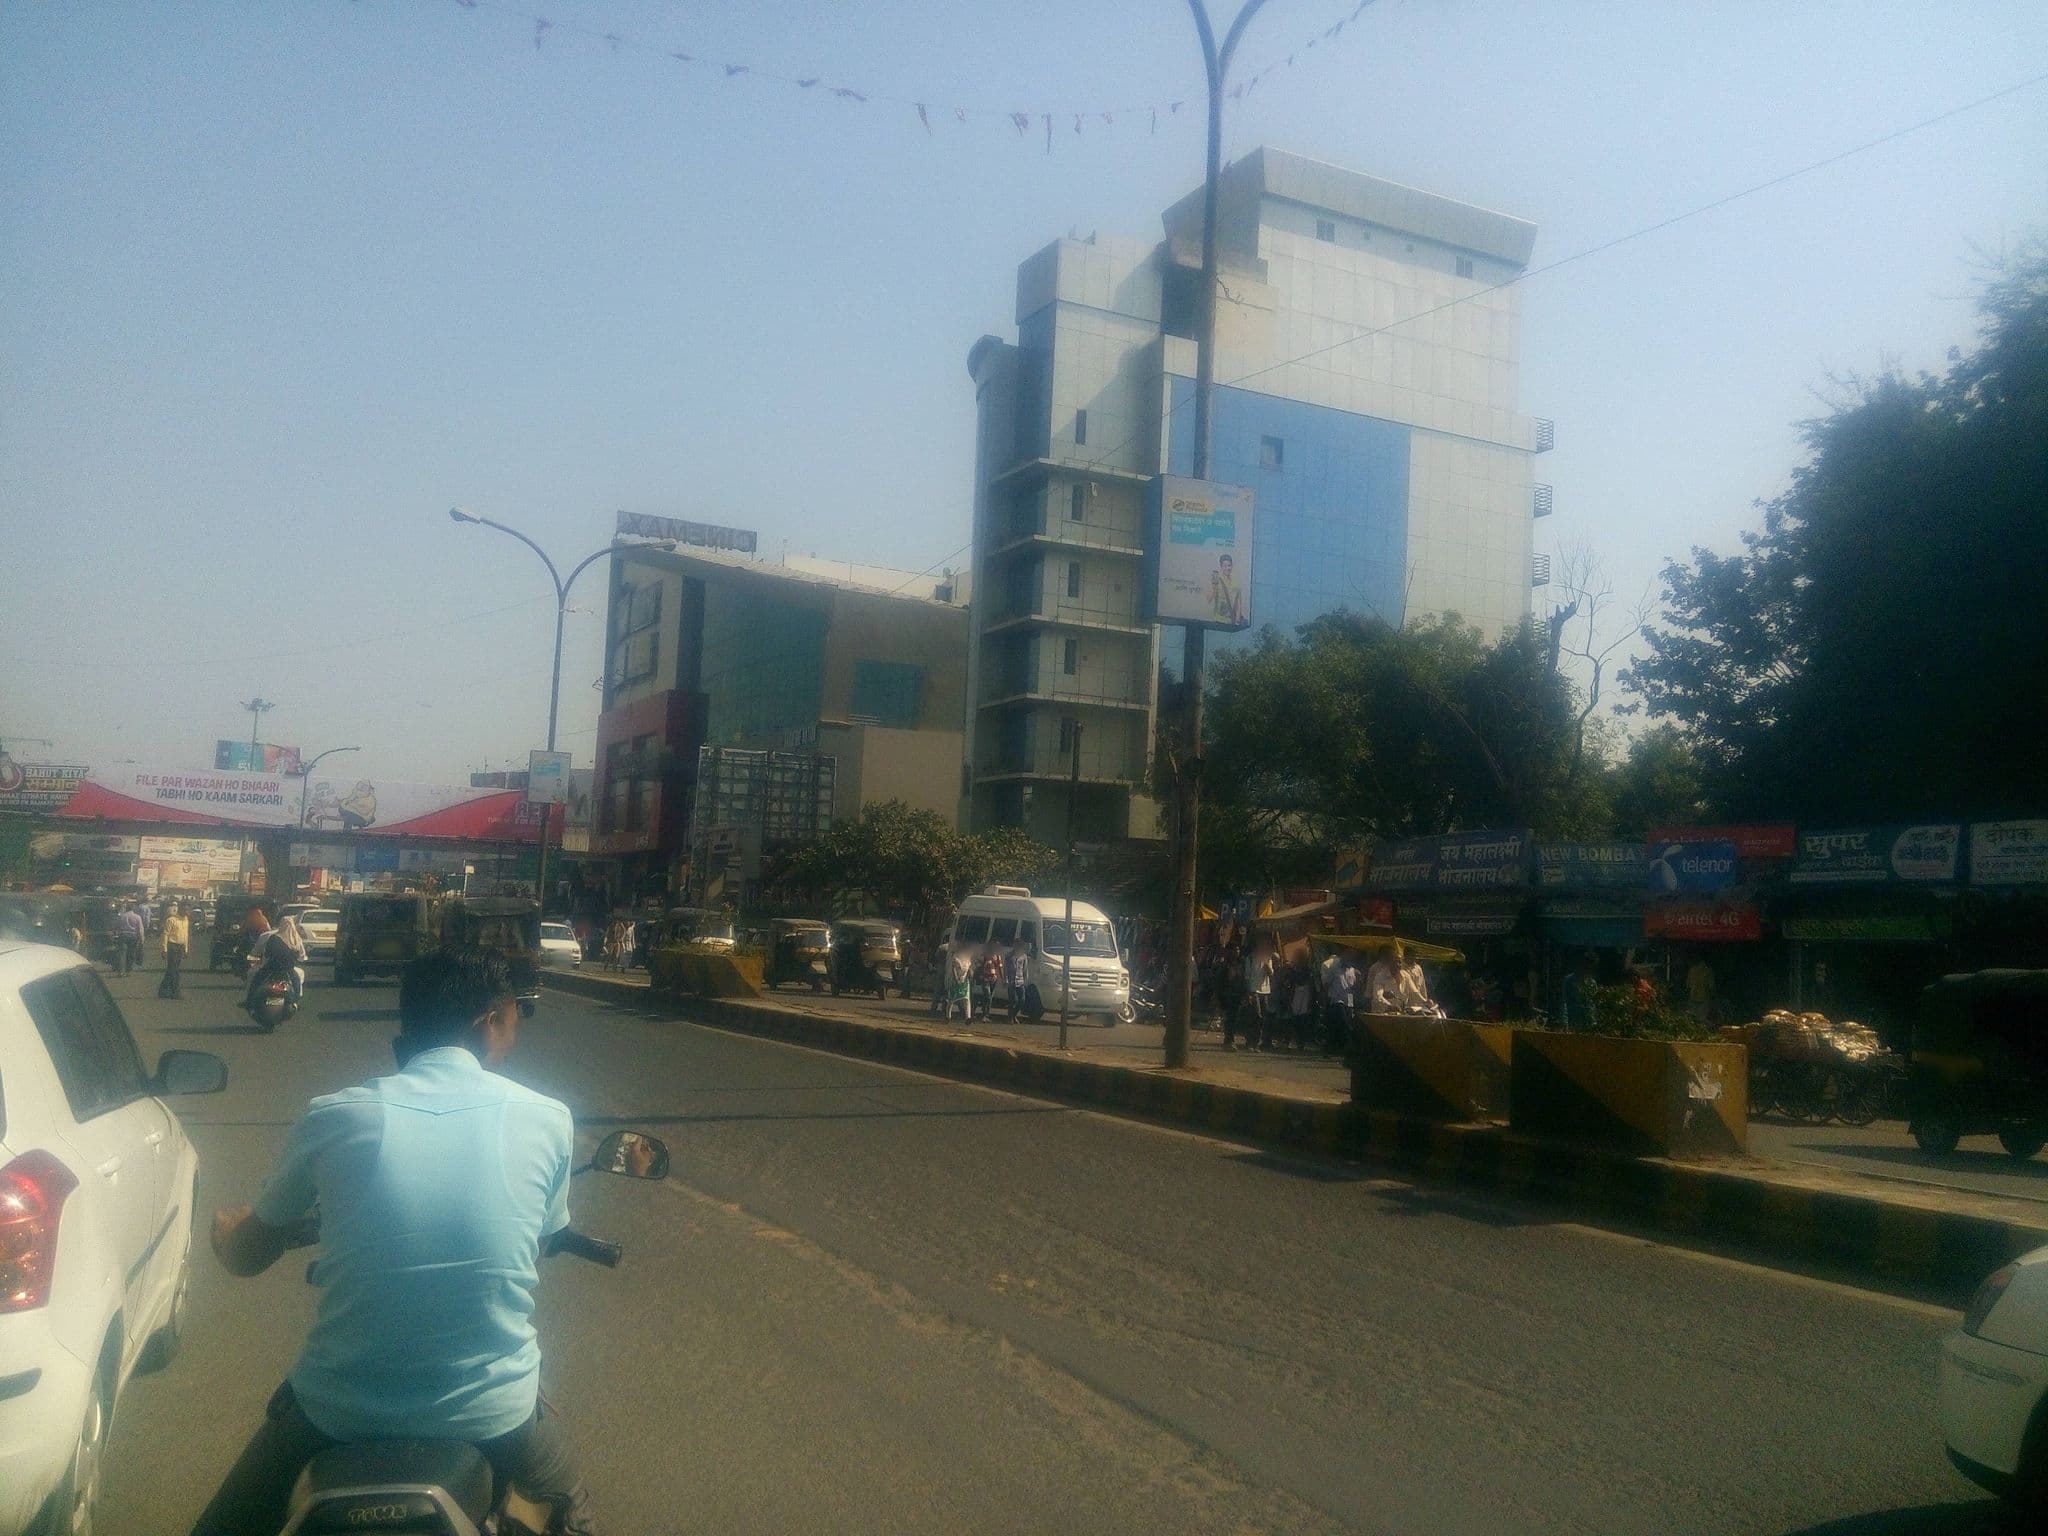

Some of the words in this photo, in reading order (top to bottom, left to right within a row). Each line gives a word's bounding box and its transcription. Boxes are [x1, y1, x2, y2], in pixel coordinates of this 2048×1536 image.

[136, 775, 157, 785] FILE
[162, 776, 182, 787] PAR
[185, 777, 223, 790] WAZAN
[225, 780, 239, 790] HO
[242, 780, 279, 792] BHAARI
[156, 788, 186, 799] TABHI
[188, 790, 202, 800] HO
[205, 792, 236, 803] KAAM
[239, 794, 283, 805] SARKARI
[1540, 847, 1571, 861] NEW
[1682, 856, 1733, 873] telenor
[1678, 912, 1713, 926] airtel
[1719, 912, 1740, 927] 4G
